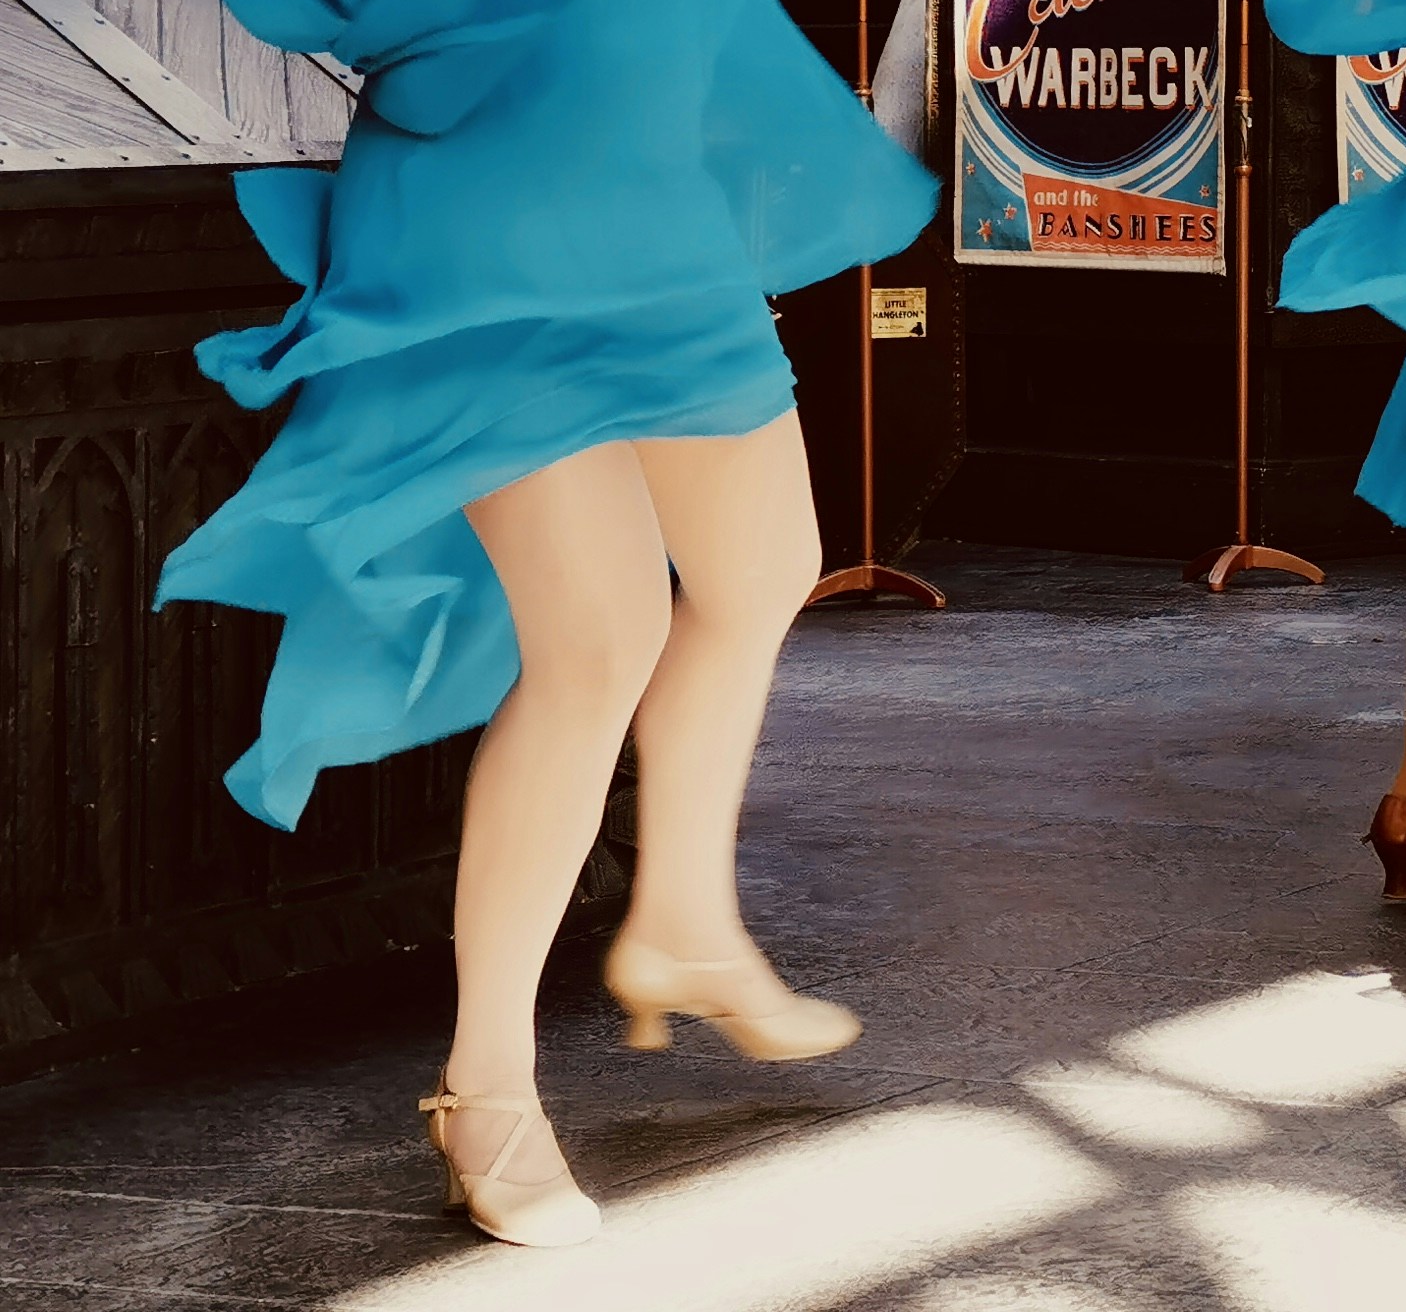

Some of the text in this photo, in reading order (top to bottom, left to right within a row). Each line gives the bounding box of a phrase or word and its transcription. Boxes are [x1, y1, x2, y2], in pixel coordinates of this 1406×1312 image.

[990, 46, 1215, 111] WARBECK
[1034, 189, 1100, 207] and the
[1038, 212, 1217, 242] BANSHEES
[884, 300, 907, 309] LITTLE
[872, 310, 919, 319] HANGLETON
